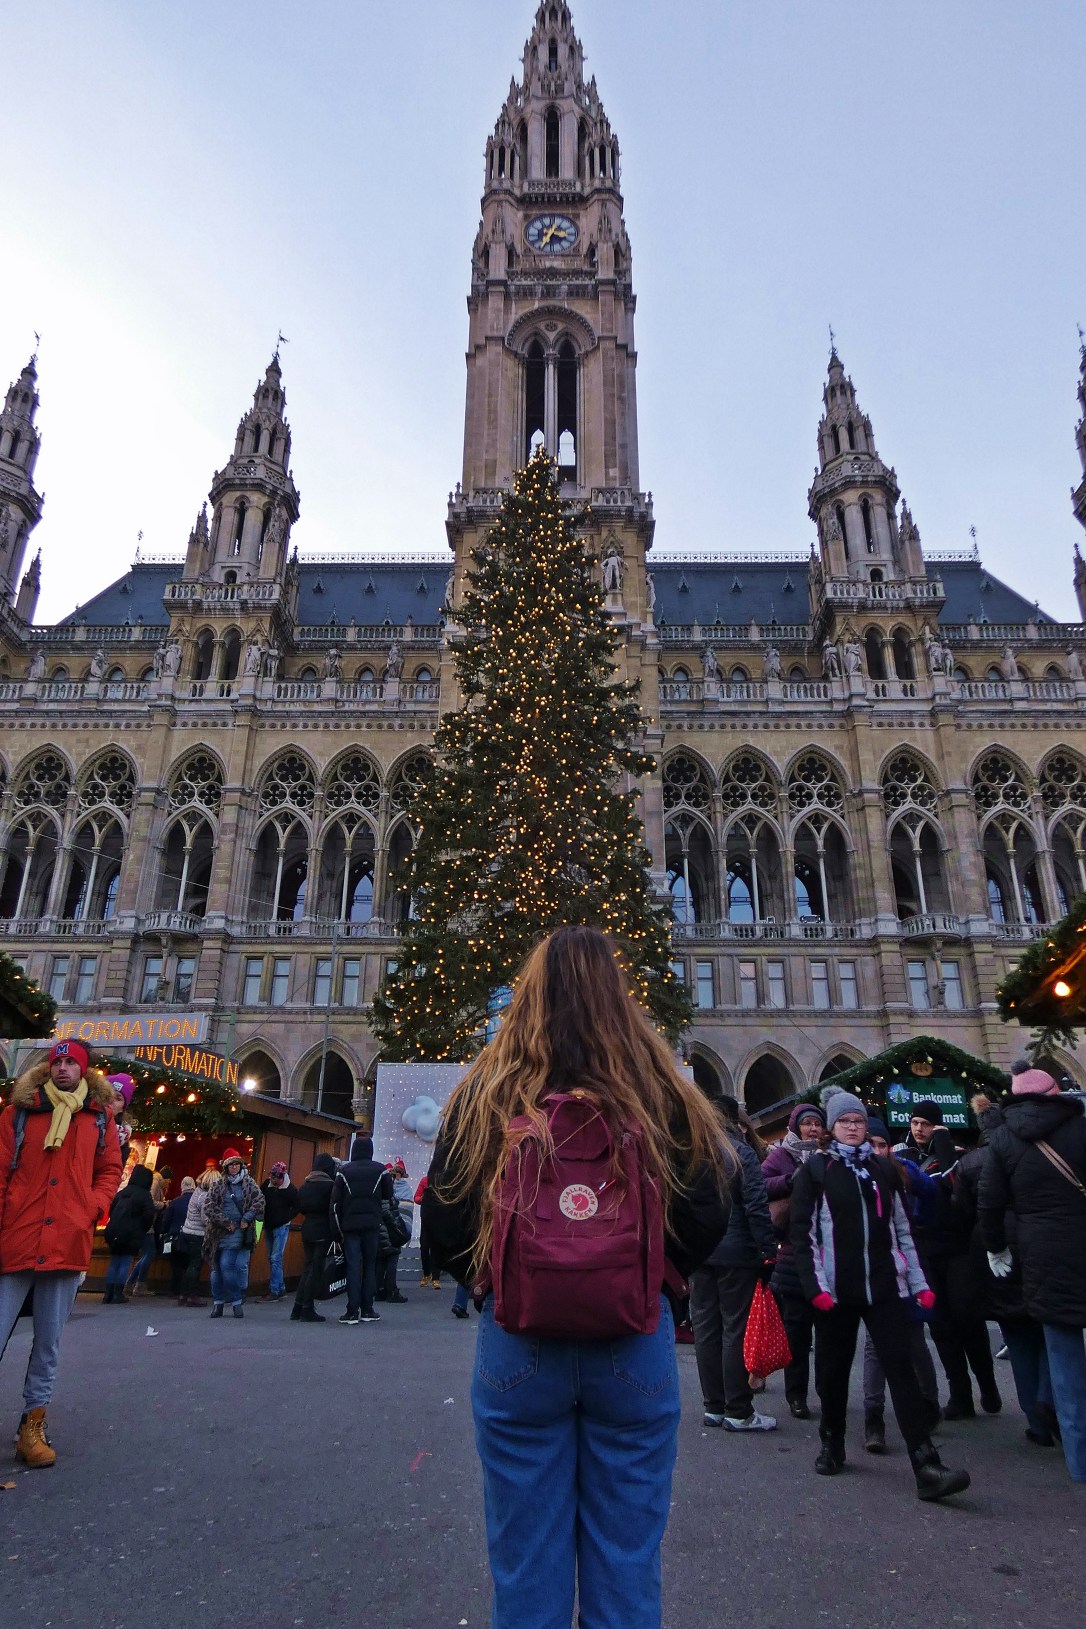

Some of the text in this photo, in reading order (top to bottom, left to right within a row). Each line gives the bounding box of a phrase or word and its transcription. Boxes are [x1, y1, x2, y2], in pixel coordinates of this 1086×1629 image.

[51, 1018, 199, 1041] NFORMATION
[55, 1042, 70, 1057] M
[912, 1092, 963, 1104] Bankomat
[891, 1111, 966, 1123] Fotmat
